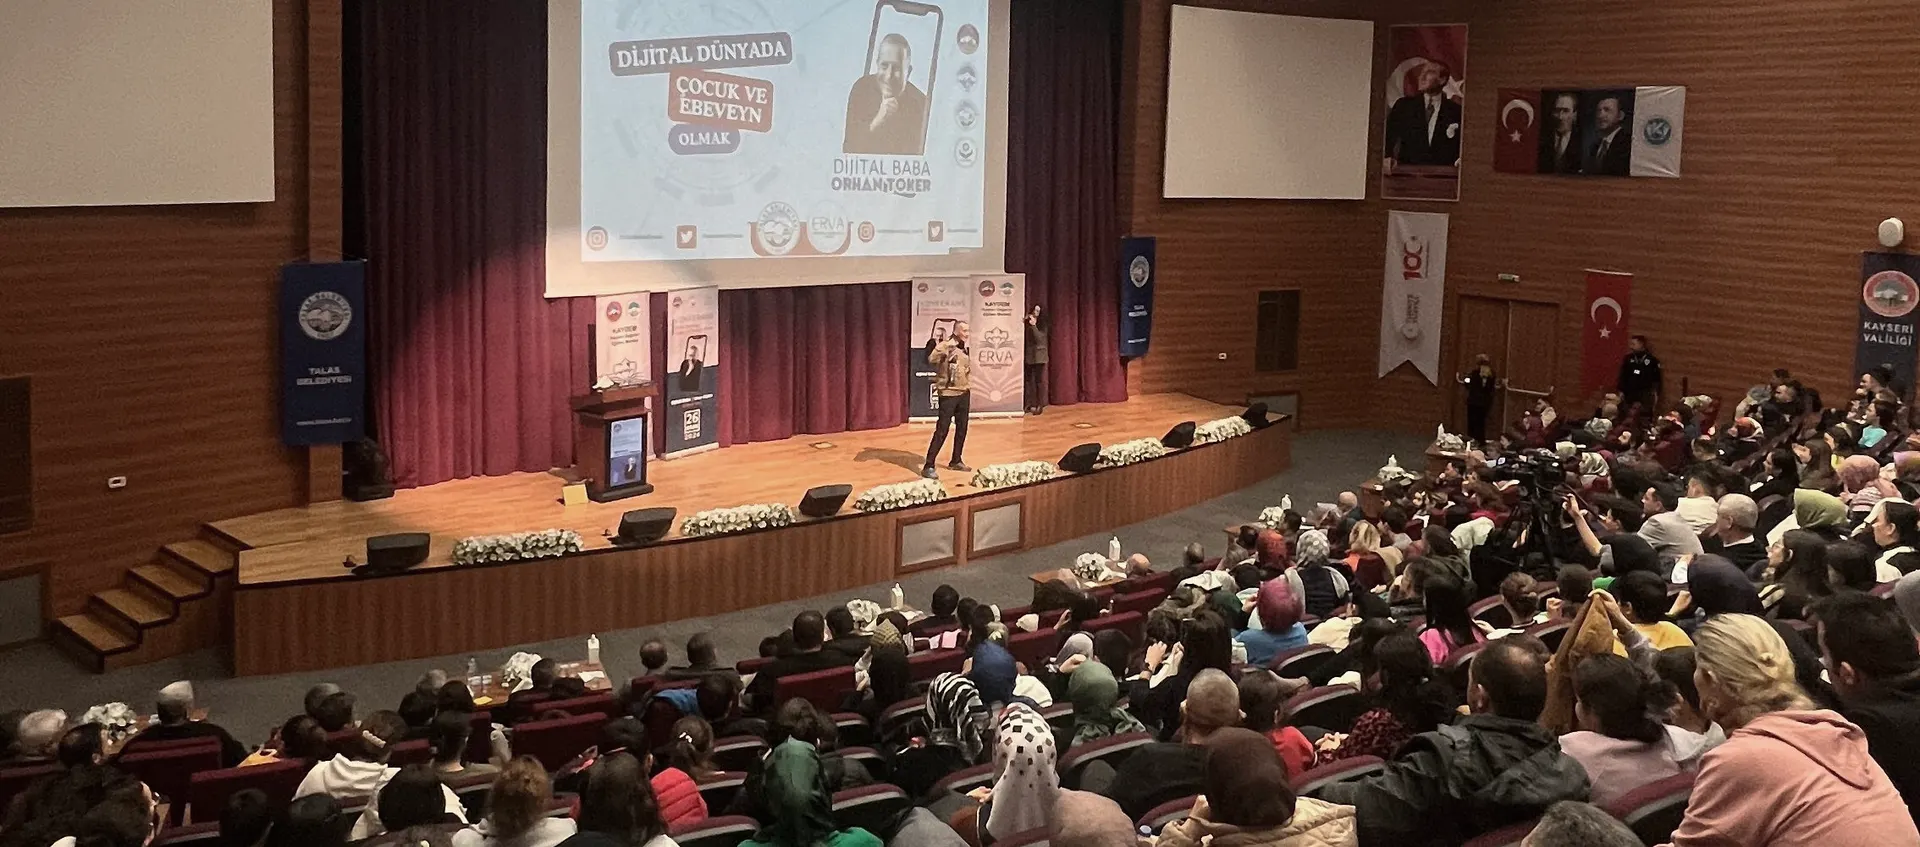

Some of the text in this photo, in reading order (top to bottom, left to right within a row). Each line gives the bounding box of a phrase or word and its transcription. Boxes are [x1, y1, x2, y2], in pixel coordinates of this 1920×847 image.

[616, 40, 787, 68] DİJİTAL DÜNYADA
[676, 76, 768, 104] ÇOCUK VE
[679, 98, 762, 123] EBEVEYN
[678, 132, 731, 146] OLMAK
[892, 160, 931, 176] BABA
[831, 177, 883, 191] ORHAN
[1863, 321, 1914, 334] KAYSERİ
[1863, 333, 1912, 346] VALİLİĞİ
[978, 350, 1013, 362] ERVA
[686, 412, 700, 424] 26
